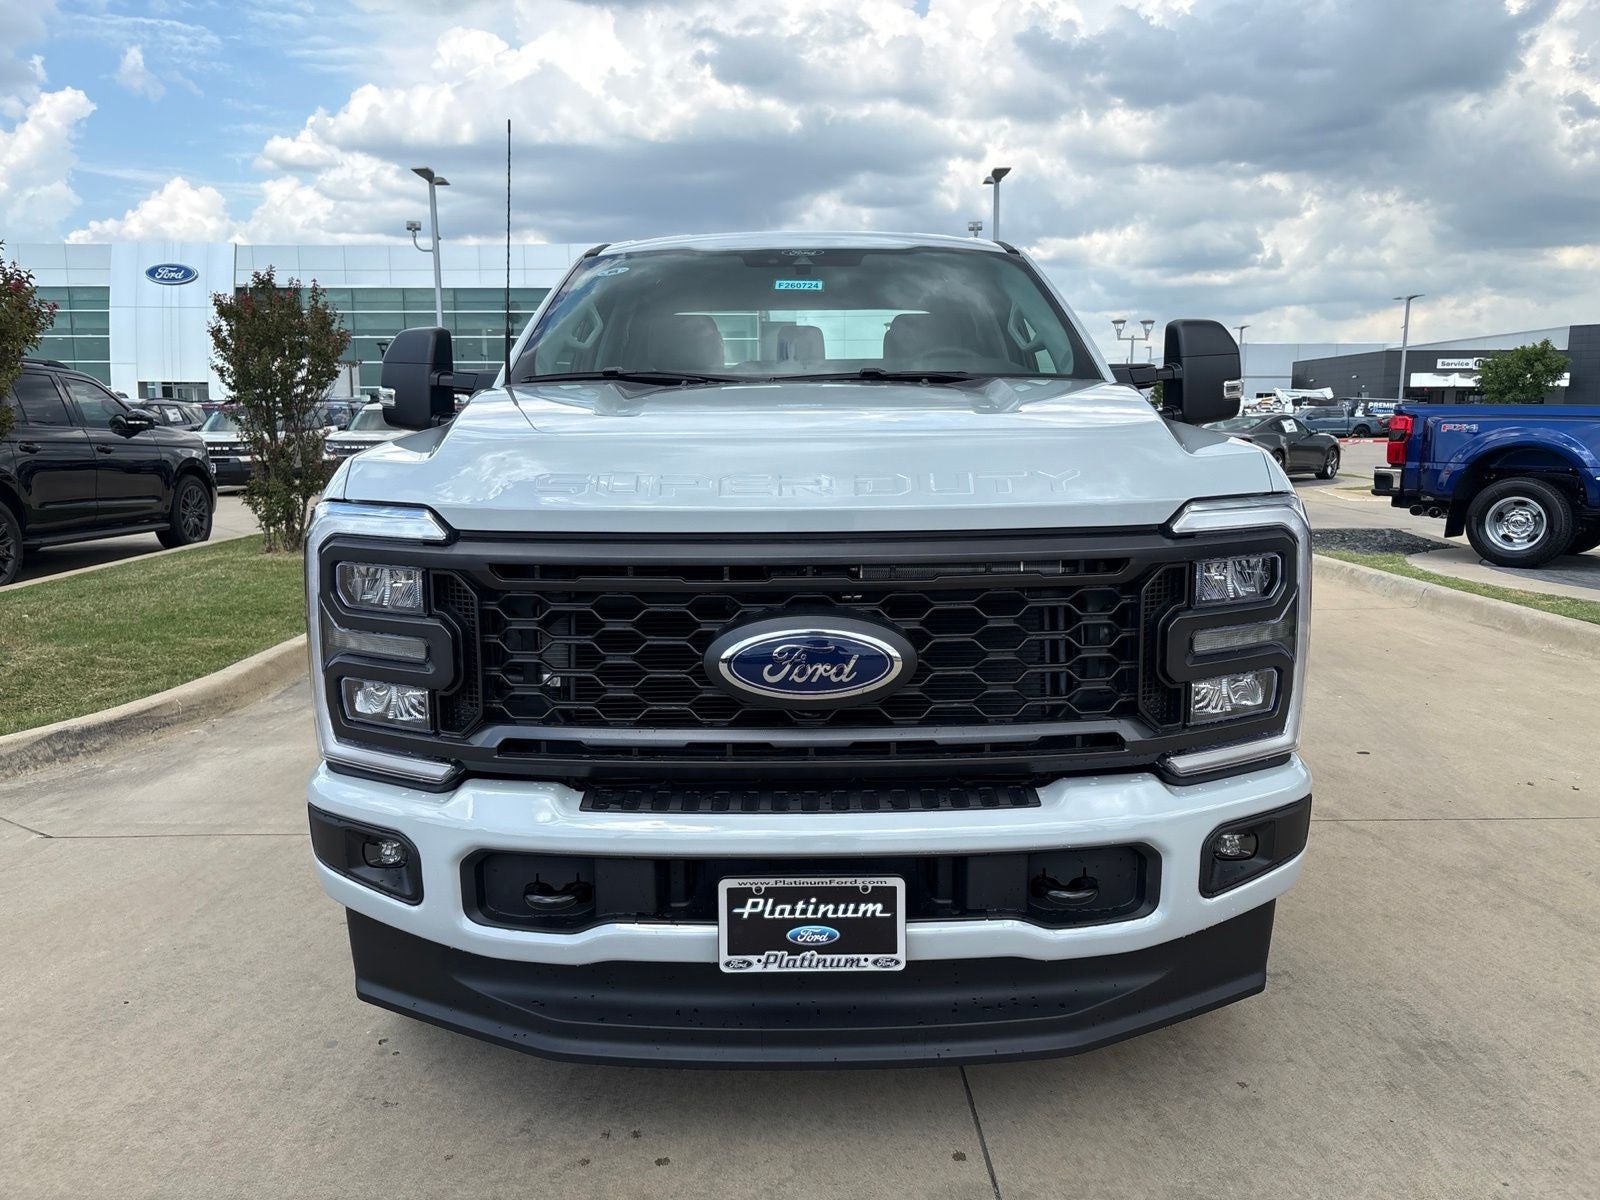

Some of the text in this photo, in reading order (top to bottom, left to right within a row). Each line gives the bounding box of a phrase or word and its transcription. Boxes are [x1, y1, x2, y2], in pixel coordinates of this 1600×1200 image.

[155, 266, 185, 279] Ford
[534, 469, 1081, 498] SUPER DUTY
[762, 644, 858, 684] Ford
[737, 879, 888, 887] www.PlatinumFord.com
[732, 897, 892, 919] Platinum
[797, 928, 829, 942] Ford
[728, 952, 896, 970] Ford Platinum Ford
